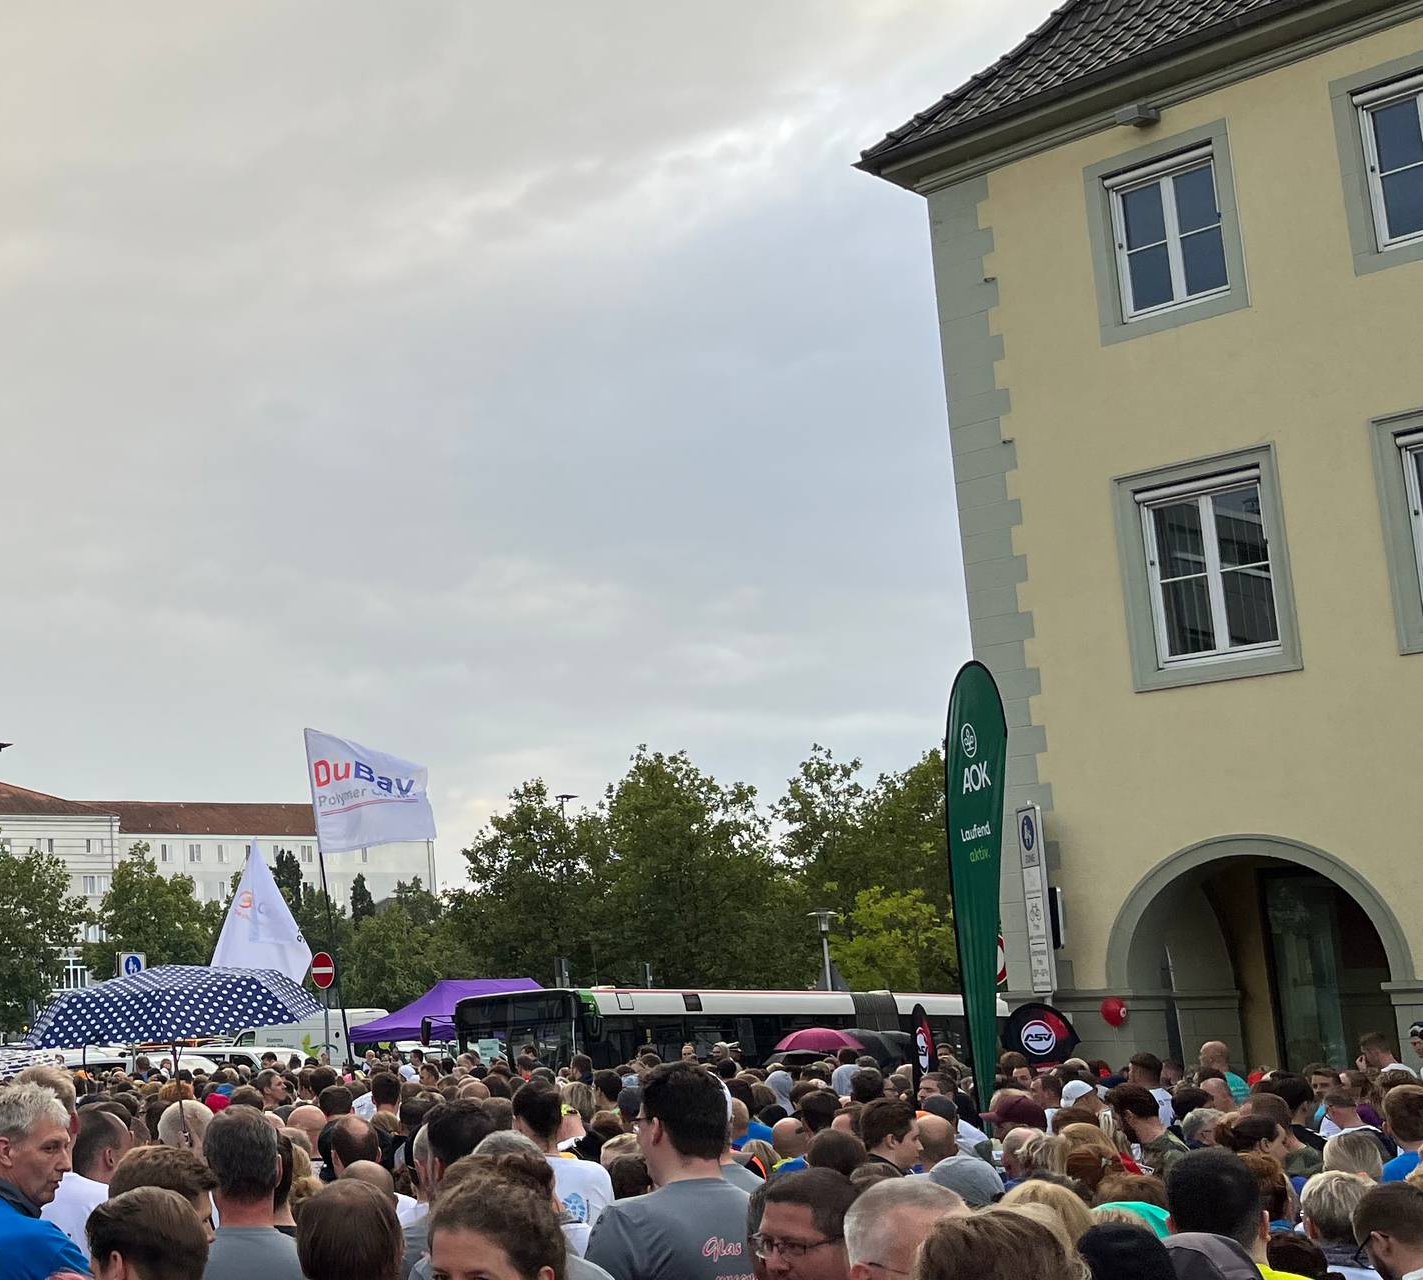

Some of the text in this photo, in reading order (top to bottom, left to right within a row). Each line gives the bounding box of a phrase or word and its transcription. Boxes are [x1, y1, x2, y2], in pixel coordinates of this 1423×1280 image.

[963, 761, 991, 794] AOK
[319, 787, 367, 806] Polymer
[961, 821, 991, 842] Laufend
[1024, 1033, 1052, 1041] ASV
[702, 1236, 742, 1262] Glas
